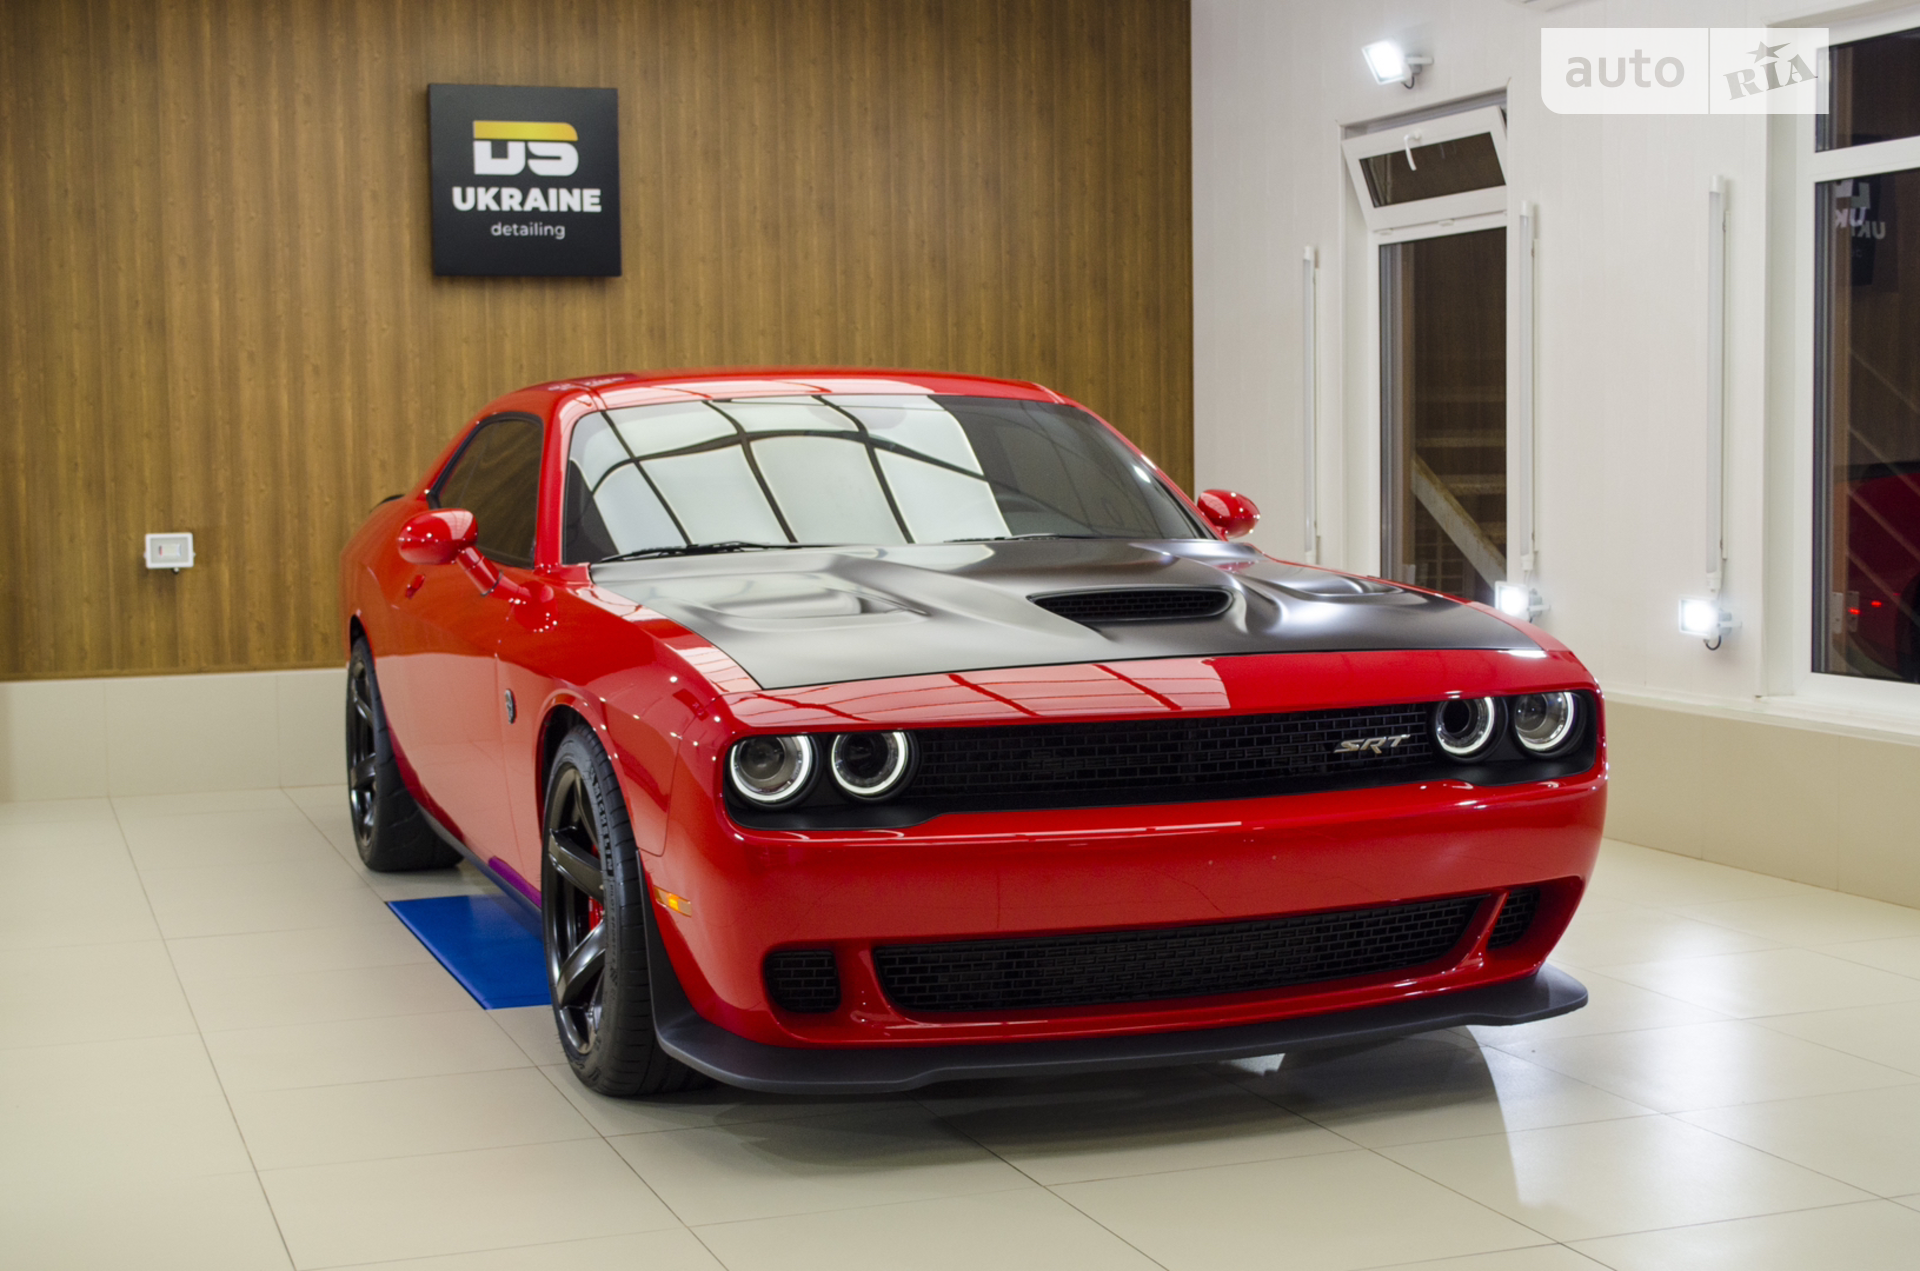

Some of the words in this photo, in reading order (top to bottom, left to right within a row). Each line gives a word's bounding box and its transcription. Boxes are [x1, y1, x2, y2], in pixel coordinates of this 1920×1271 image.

[452, 186, 602, 212] UKRAINE
[490, 222, 566, 239] detailing
[1333, 733, 1411, 754] SRT
